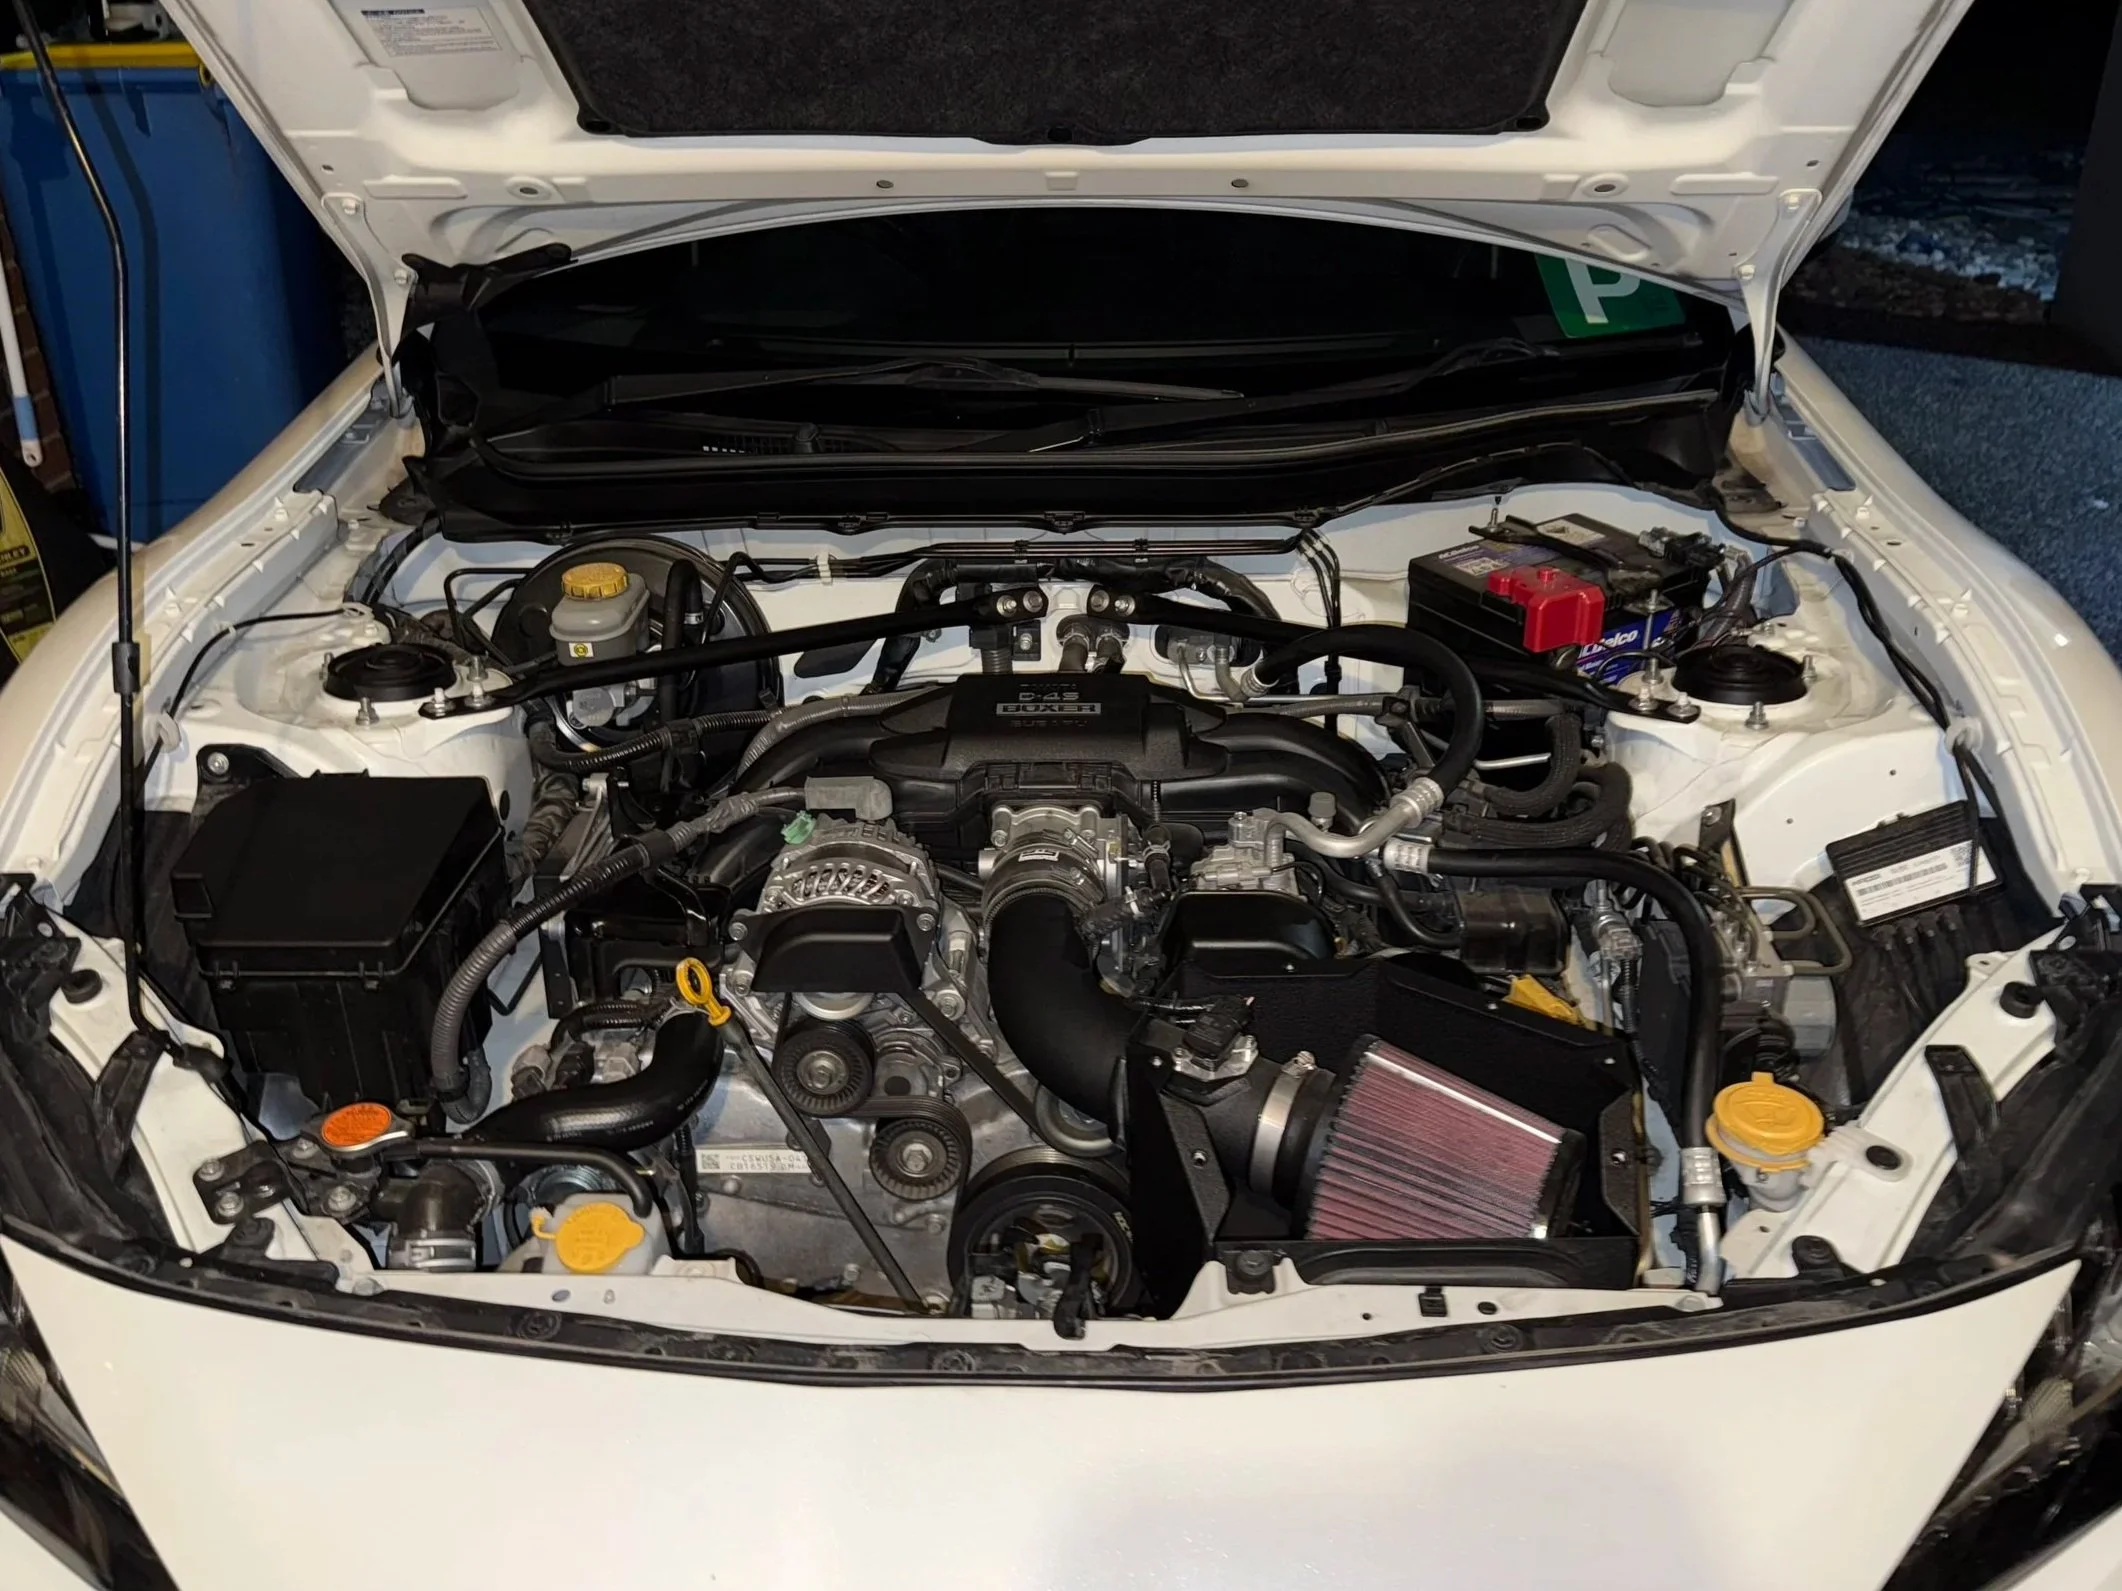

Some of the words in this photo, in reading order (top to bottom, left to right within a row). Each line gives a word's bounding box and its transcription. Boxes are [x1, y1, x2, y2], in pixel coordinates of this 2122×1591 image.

[1564, 257, 1640, 324] P
[1019, 691, 1079, 701] D-4S
[1002, 704, 1096, 713] BOXER
